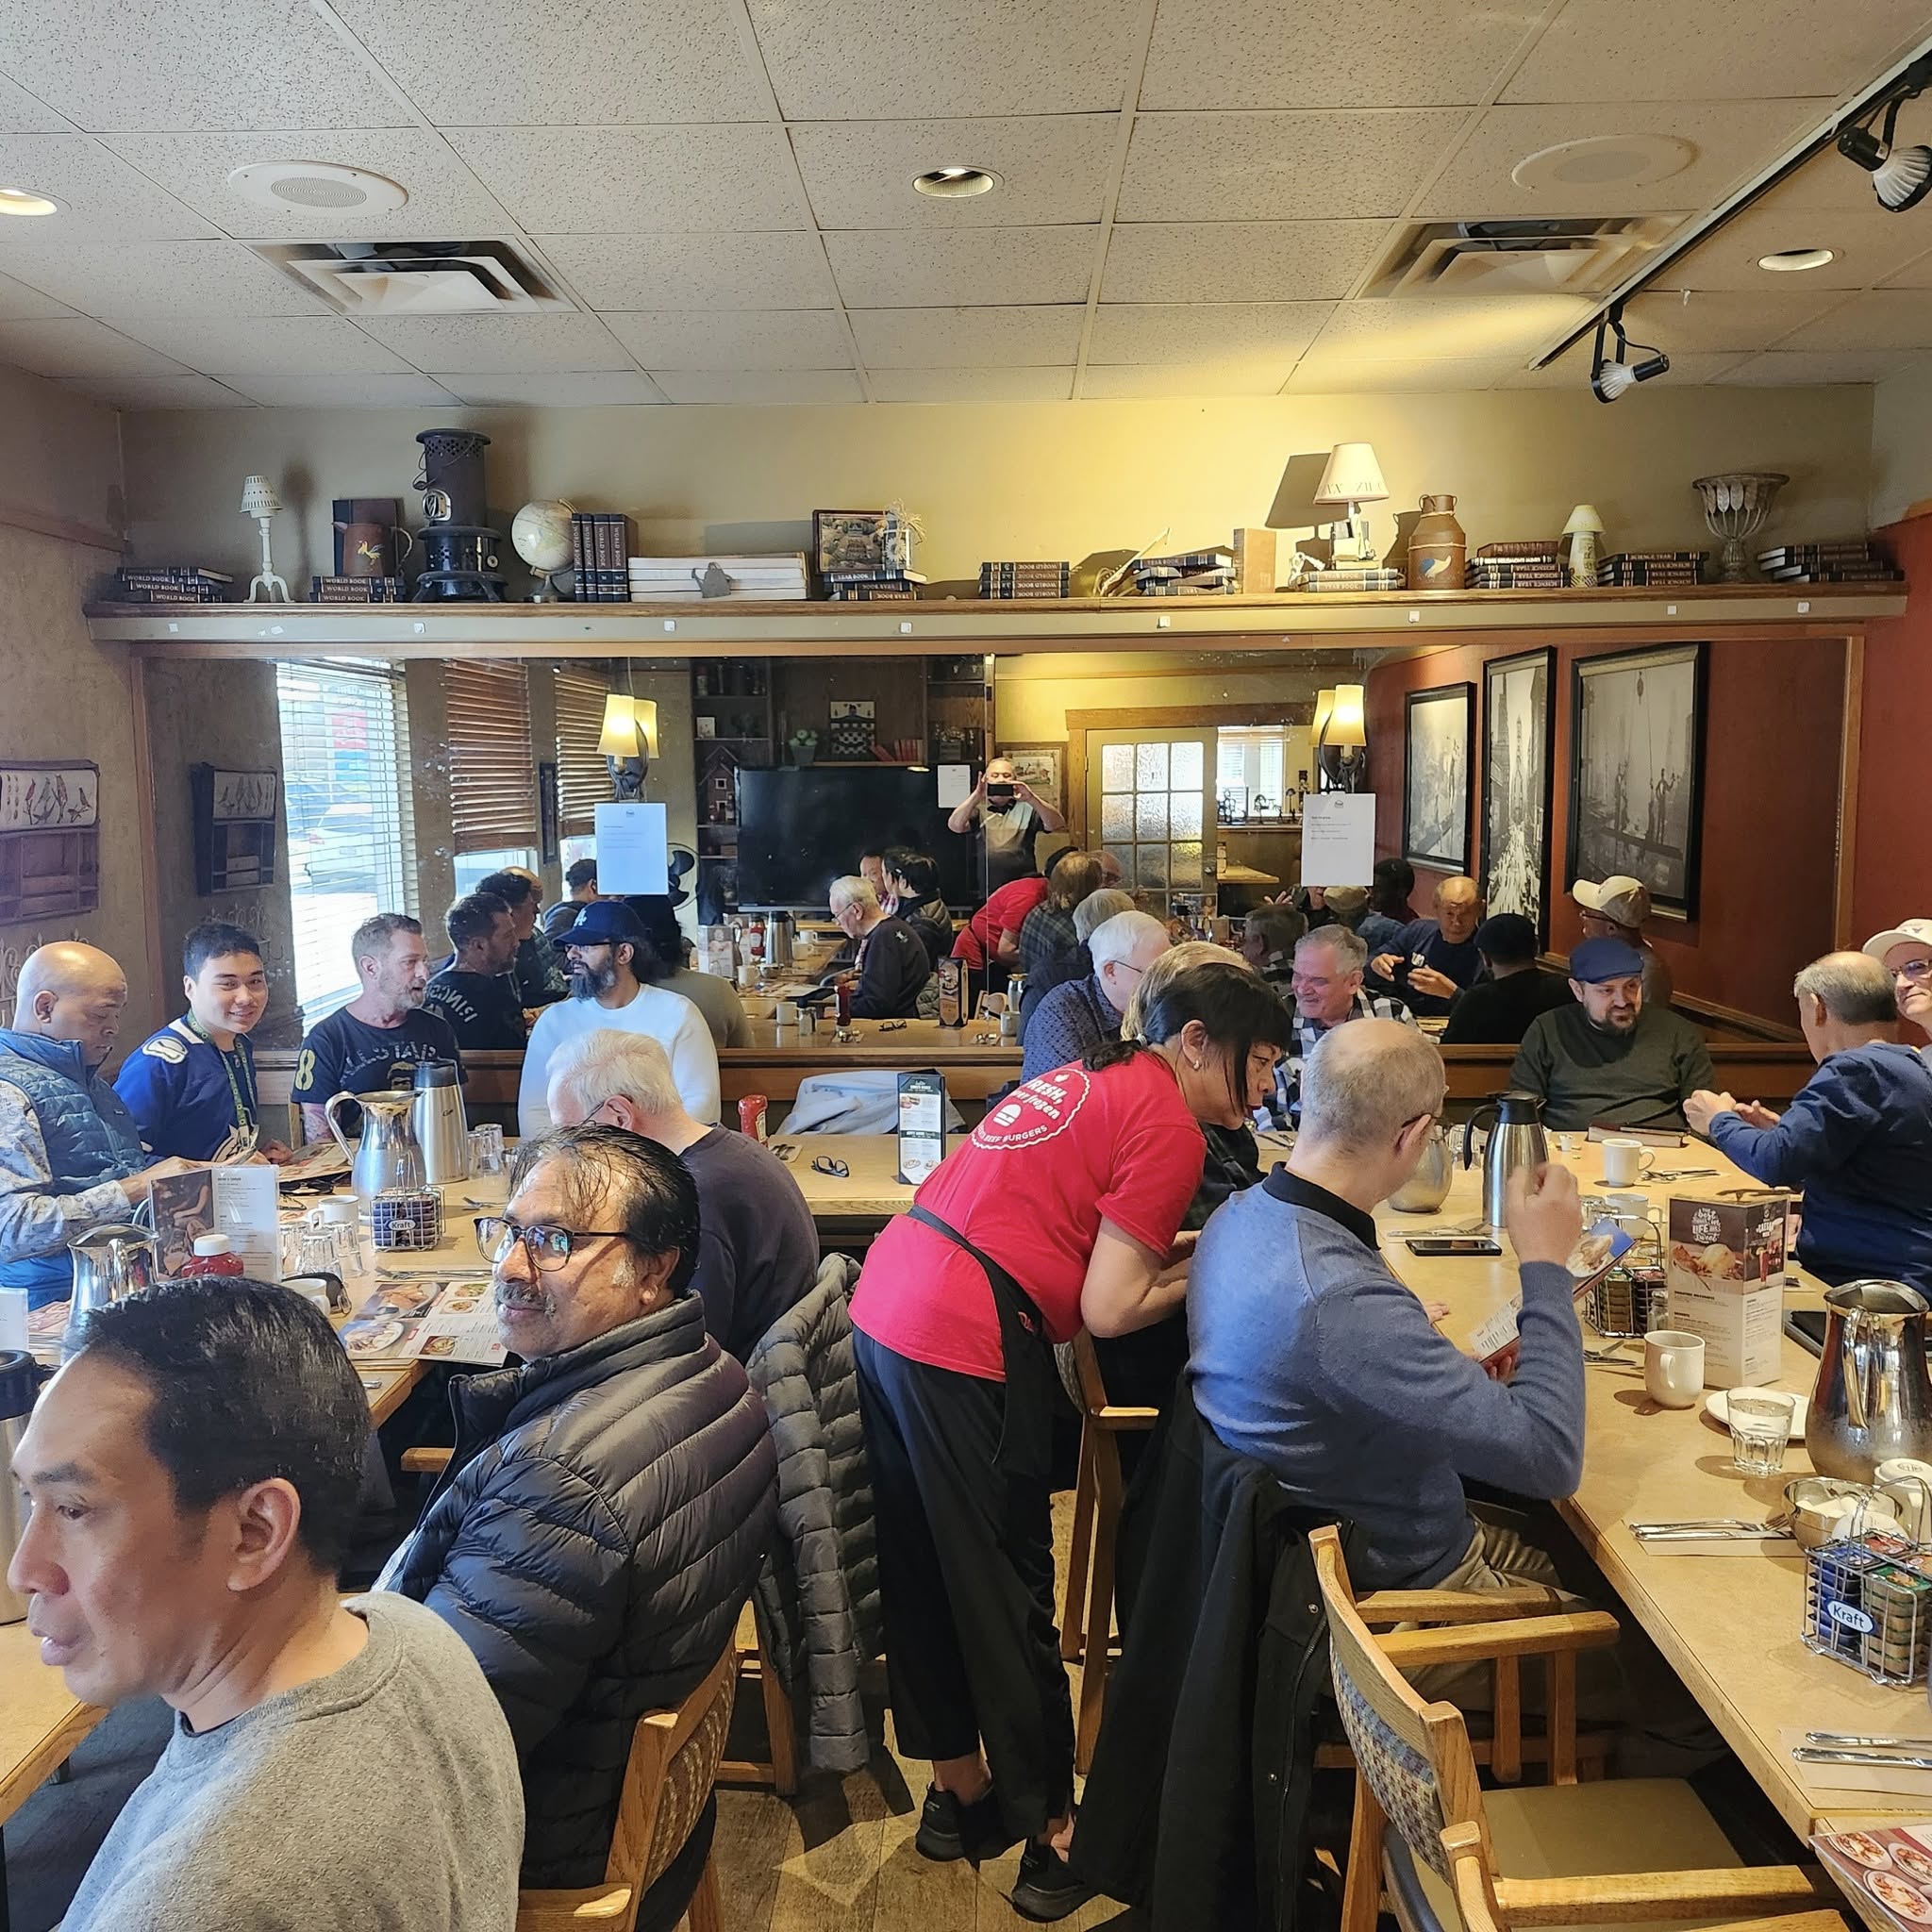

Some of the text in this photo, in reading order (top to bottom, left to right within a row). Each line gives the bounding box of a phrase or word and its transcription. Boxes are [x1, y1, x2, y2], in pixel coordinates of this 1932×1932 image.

[294, 1049, 316, 1091] 8
[1024, 1078, 1068, 1106] RESH,
[1022, 1094, 1060, 1121] frozen
[1002, 1124, 1048, 1143] BURGERS
[1692, 1224, 1709, 1234] LIFE
[1832, 1604, 1864, 1628] Kraft
